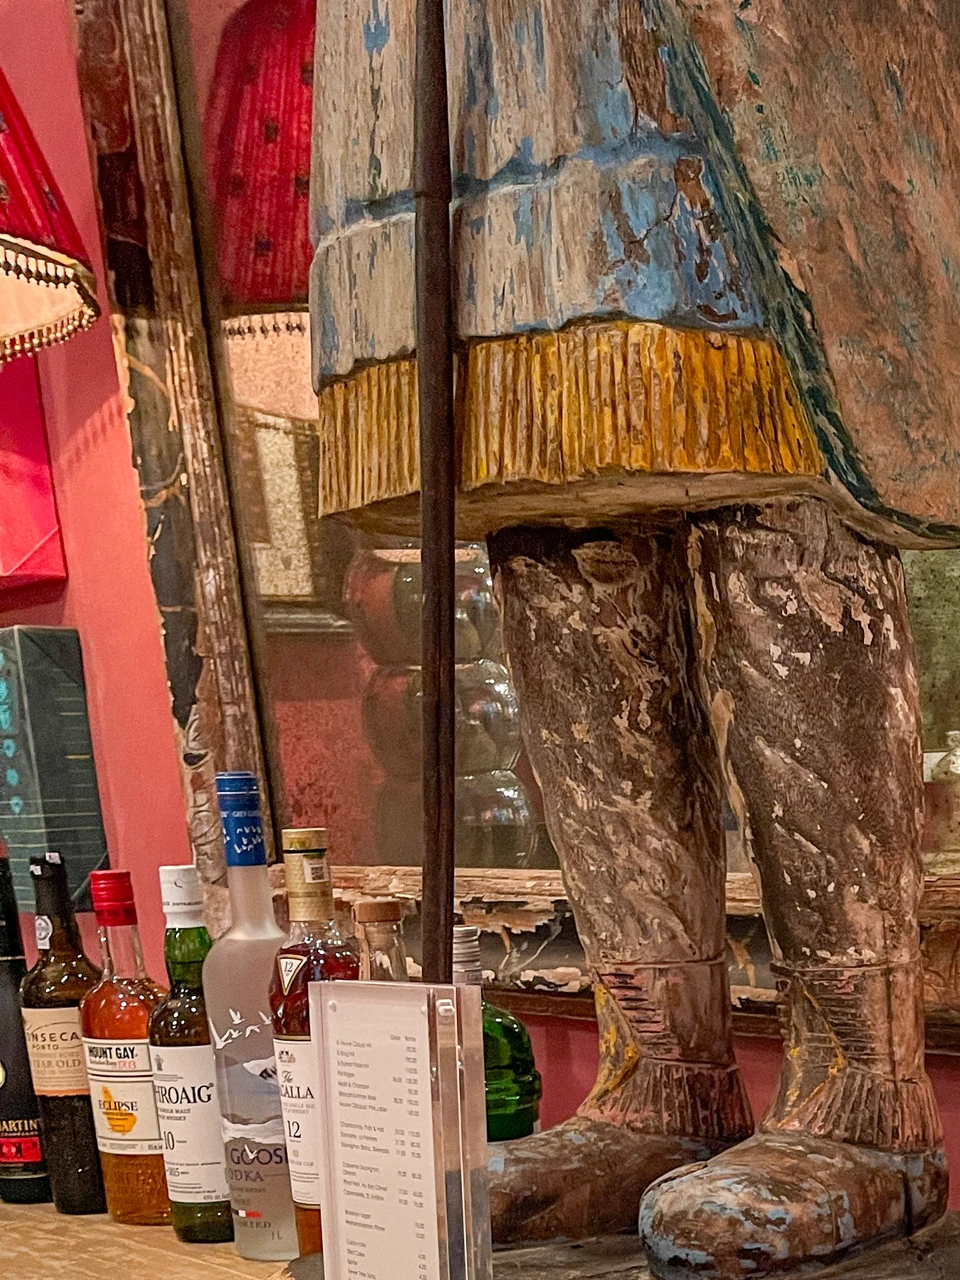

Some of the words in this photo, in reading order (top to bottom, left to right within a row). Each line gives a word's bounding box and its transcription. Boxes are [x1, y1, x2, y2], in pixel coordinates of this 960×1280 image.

[284, 961, 294, 973] 12
[116, 1047, 135, 1059] GAY
[56, 1059, 81, 1068] OLD
[99, 1099, 138, 1111] ECLIPSE
[287, 1120, 302, 1138] 12
[163, 1131, 175, 1150] 10
